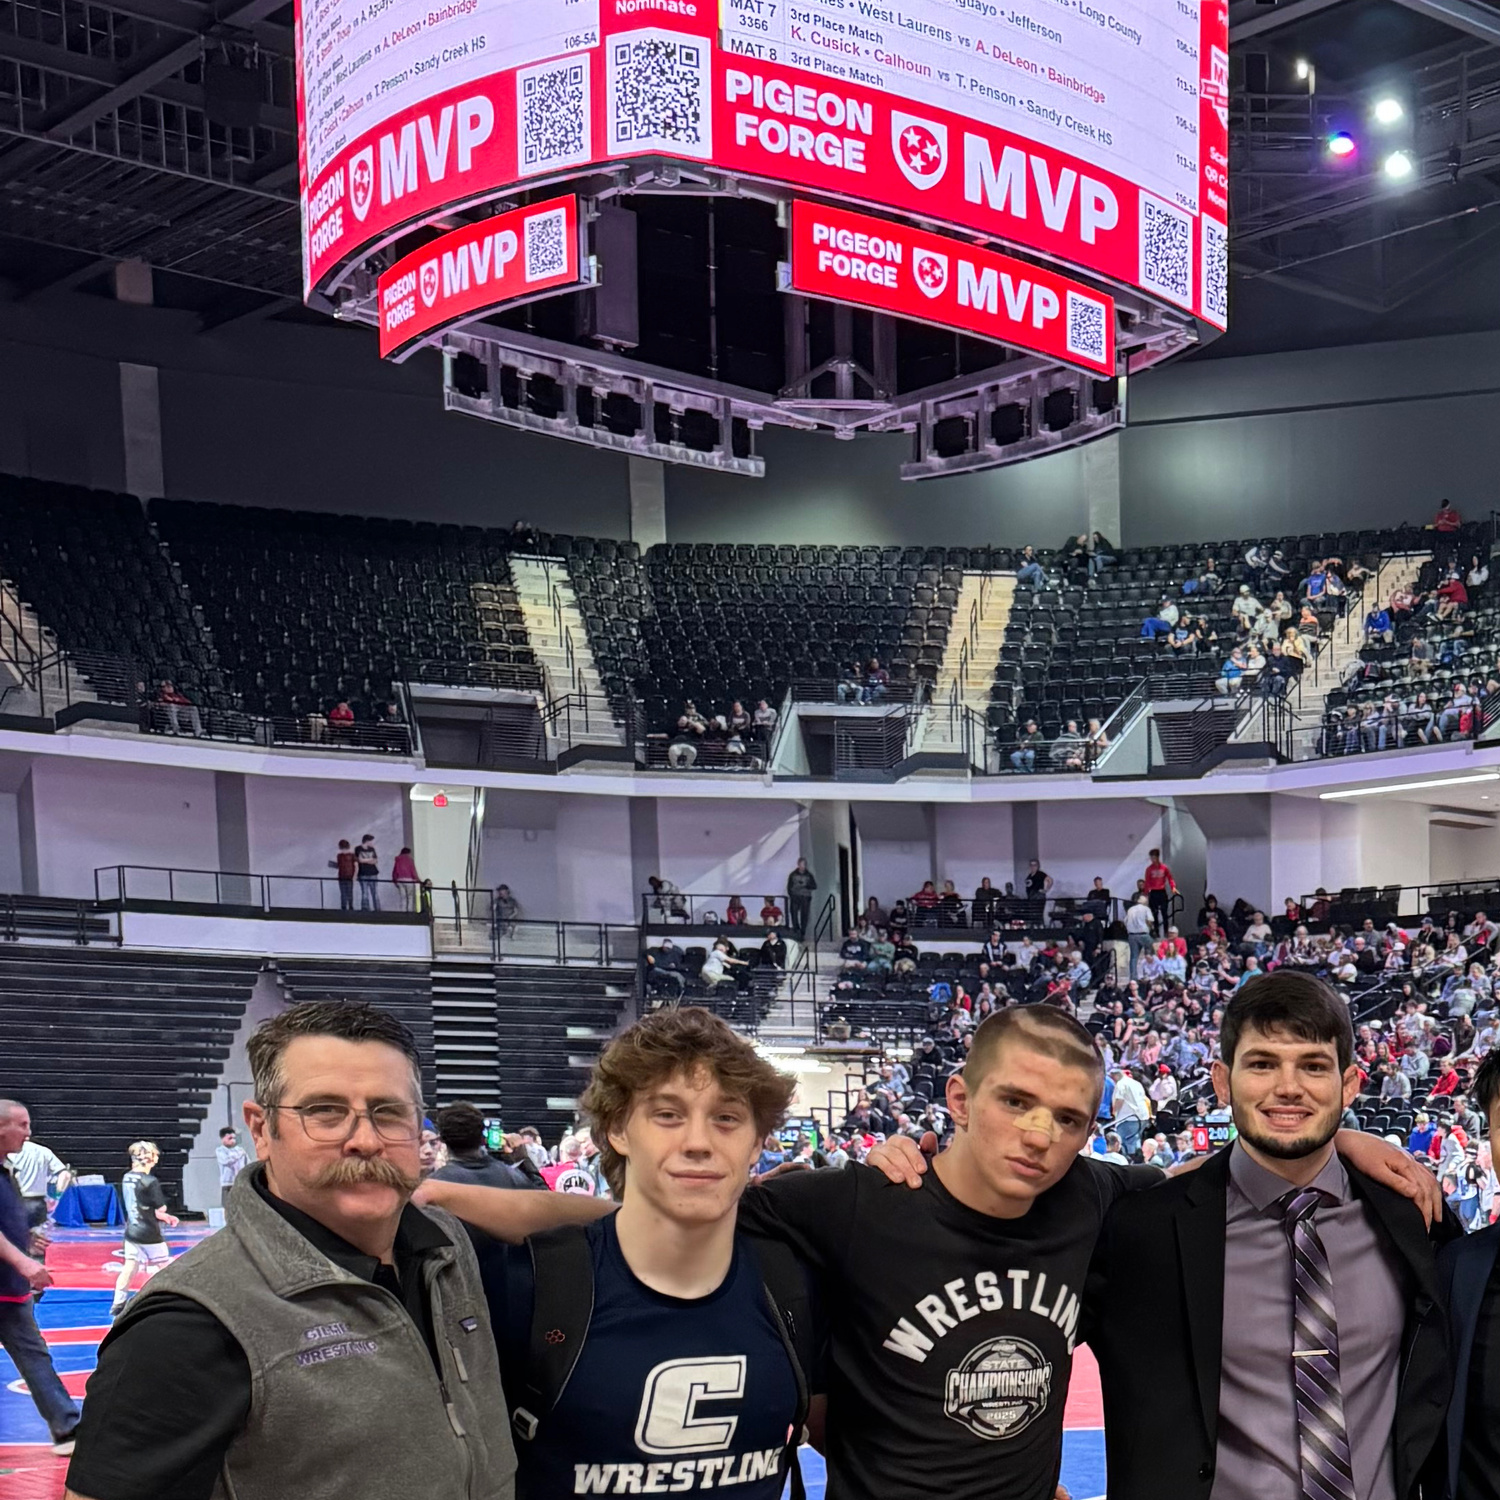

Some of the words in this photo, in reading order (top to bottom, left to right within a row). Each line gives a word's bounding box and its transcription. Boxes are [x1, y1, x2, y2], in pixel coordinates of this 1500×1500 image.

[427, 0, 477, 26] Bainbridge
[615, 0, 697, 16] Nominate
[768, 3, 776, 18] 7
[790, 8, 810, 24] 3rd
[813, 14, 845, 33] Place
[849, 25, 883, 45] Match
[1007, 11, 1062, 44] Jefferson
[1078, 0, 1105, 33] Long
[1107, 15, 1142, 46] County
[414, 54, 440, 75] Sandy
[442, 42, 469, 62] Creek
[471, 35, 486, 53] HS
[730, 38, 765, 58] MAT
[769, 48, 777, 61] 8
[790, 52, 811, 67] 3rd
[814, 57, 846, 77] Place
[849, 67, 884, 87] Match
[858, 0, 894, 24] West
[897, 12, 952, 42] Laurens
[957, 35, 971, 47] vs
[976, 39, 989, 55] A.
[992, 44, 1038, 74] DeLeon
[1048, 67, 1106, 103] Bainbridge
[726, 68, 873, 136] PIGEON
[791, 25, 806, 42] K.
[811, 31, 860, 56] Cusick
[873, 49, 931, 78] Calhoun
[937, 69, 950, 82] vs
[955, 73, 966, 89] T.
[970, 78, 1016, 106] Penson
[1027, 100, 1062, 126] Sandy
[1065, 115, 1096, 140] Creek
[1097, 128, 1113, 146] HS
[379, 95, 494, 206] MVP
[735, 112, 867, 174] FORGE
[309, 166, 344, 231] PIGEON
[963, 131, 1119, 245] MVP
[310, 206, 344, 265] FORGE
[812, 222, 902, 263] PIGEON
[441, 229, 517, 299] MVP
[818, 252, 898, 289] FORGE
[383, 270, 416, 310] PIGEON
[957, 259, 1060, 330] MVP
[386, 296, 416, 333] FORGE
[1196, 1131, 1206, 1146] 0
[1208, 1127, 1229, 1140] 2:00
[982, 1360, 1025, 1370] STATE
[634, 1354, 747, 1456] C
[947, 1365, 1050, 1414] CHAMPIONSHIPS
[986, 1410, 1017, 1420] 2025
